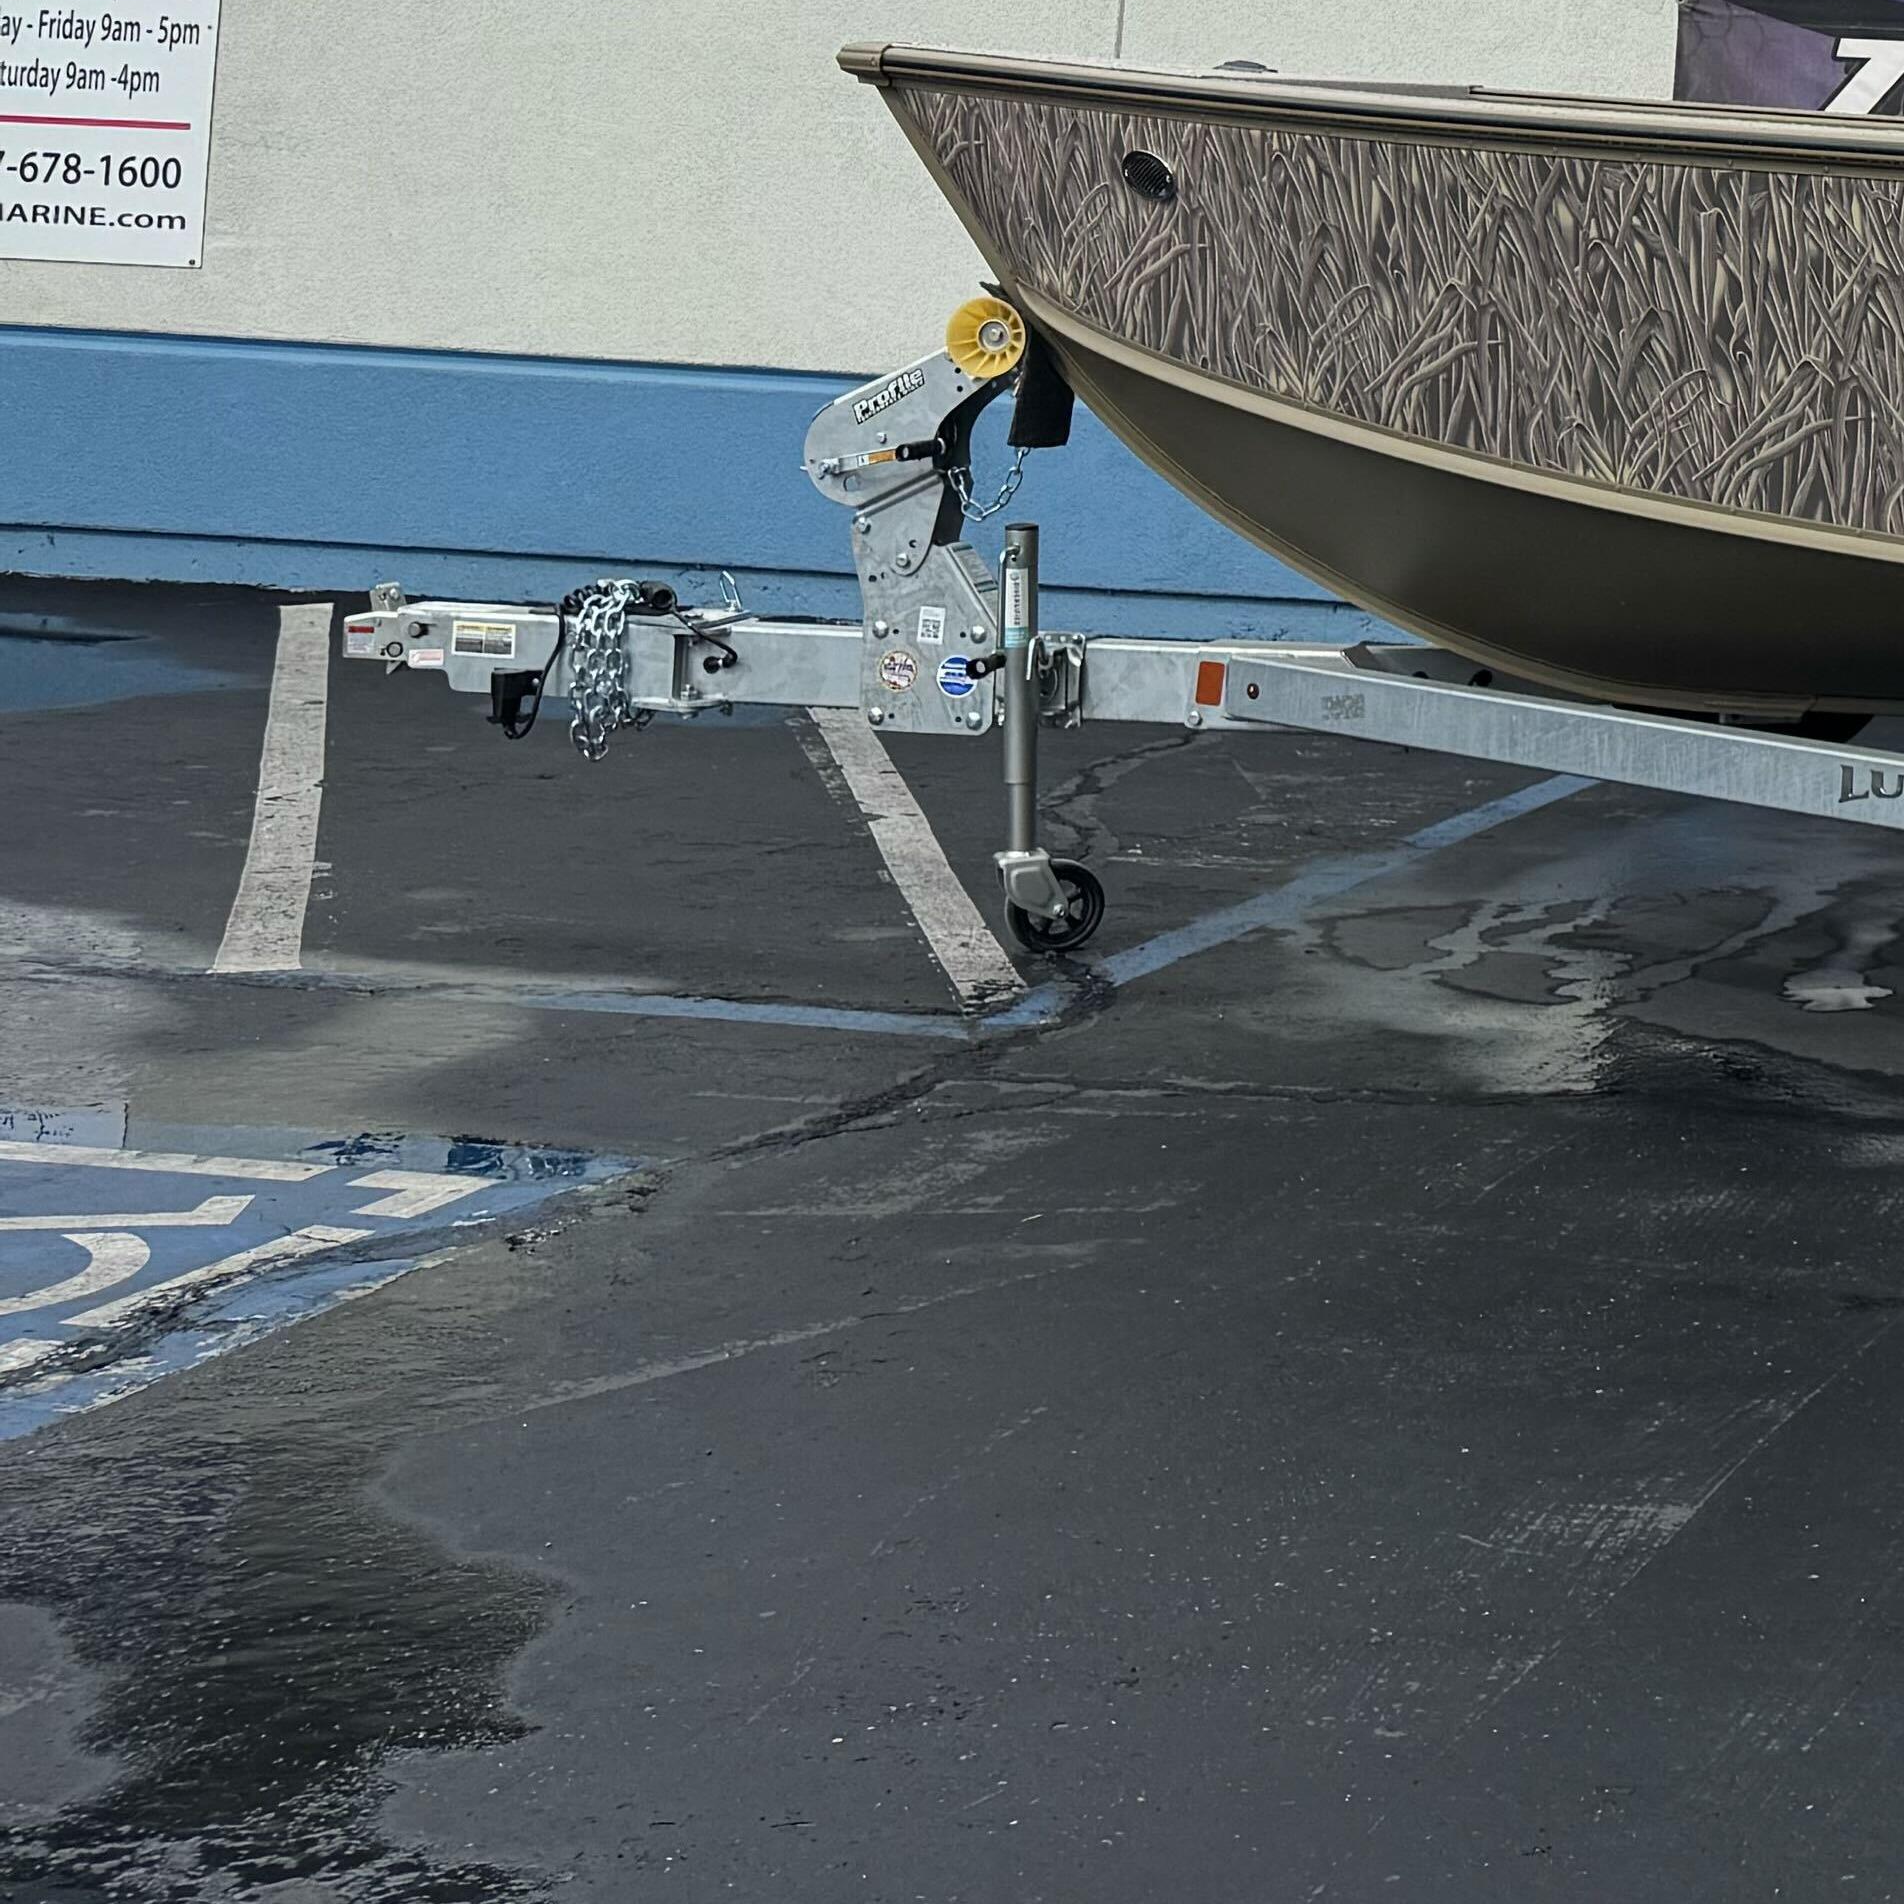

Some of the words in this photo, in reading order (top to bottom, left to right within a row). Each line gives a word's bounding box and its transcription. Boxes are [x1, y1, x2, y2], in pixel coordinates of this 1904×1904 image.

[0, 13, 22, 45] ay
[38, 9, 96, 48] Friday
[100, 13, 141, 42] 9am
[157, 15, 200, 52] 5pm
[0, 57, 61, 96] turday
[65, 61, 105, 90] 9am
[0, 202, 187, 231] ARINE.com
[853, 367, 925, 423] Profile
